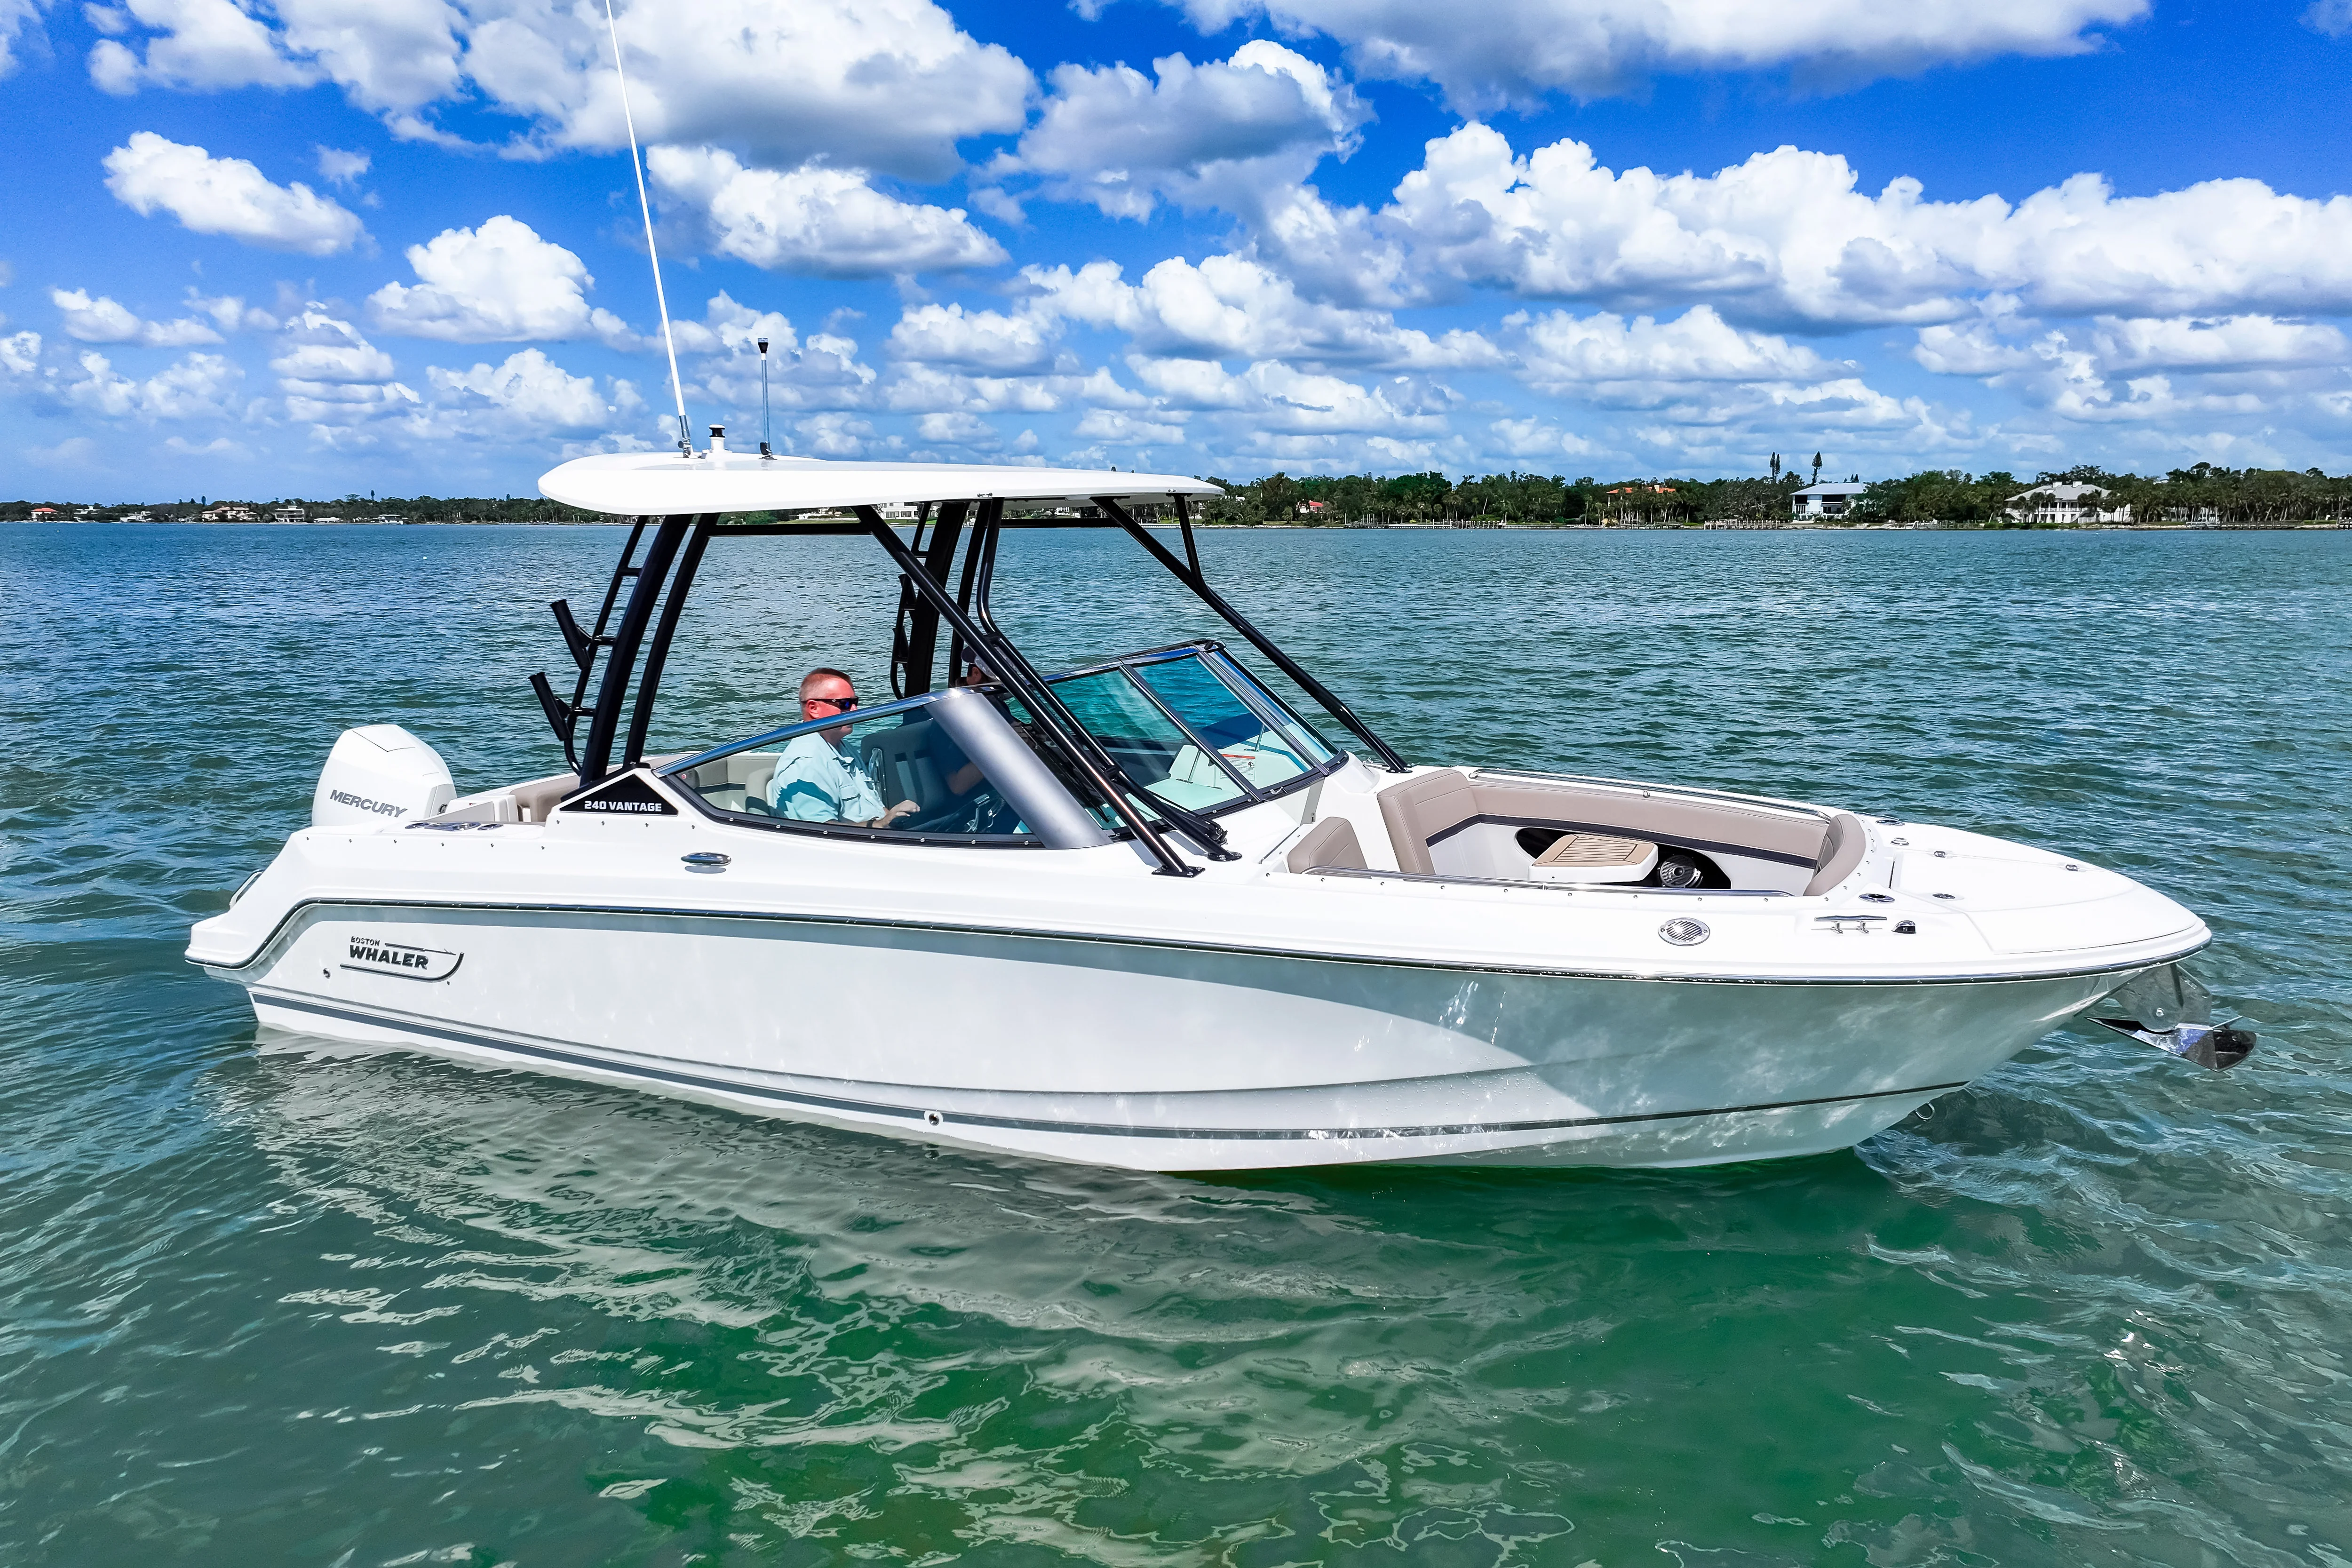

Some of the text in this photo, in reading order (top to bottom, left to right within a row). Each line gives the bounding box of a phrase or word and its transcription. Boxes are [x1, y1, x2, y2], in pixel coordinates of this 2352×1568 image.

[330, 789, 407, 818] MERCURY
[584, 801, 662, 812] 240 VANTAGE
[350, 936, 380, 947] BOSTON
[350, 945, 429, 970] WHALER
